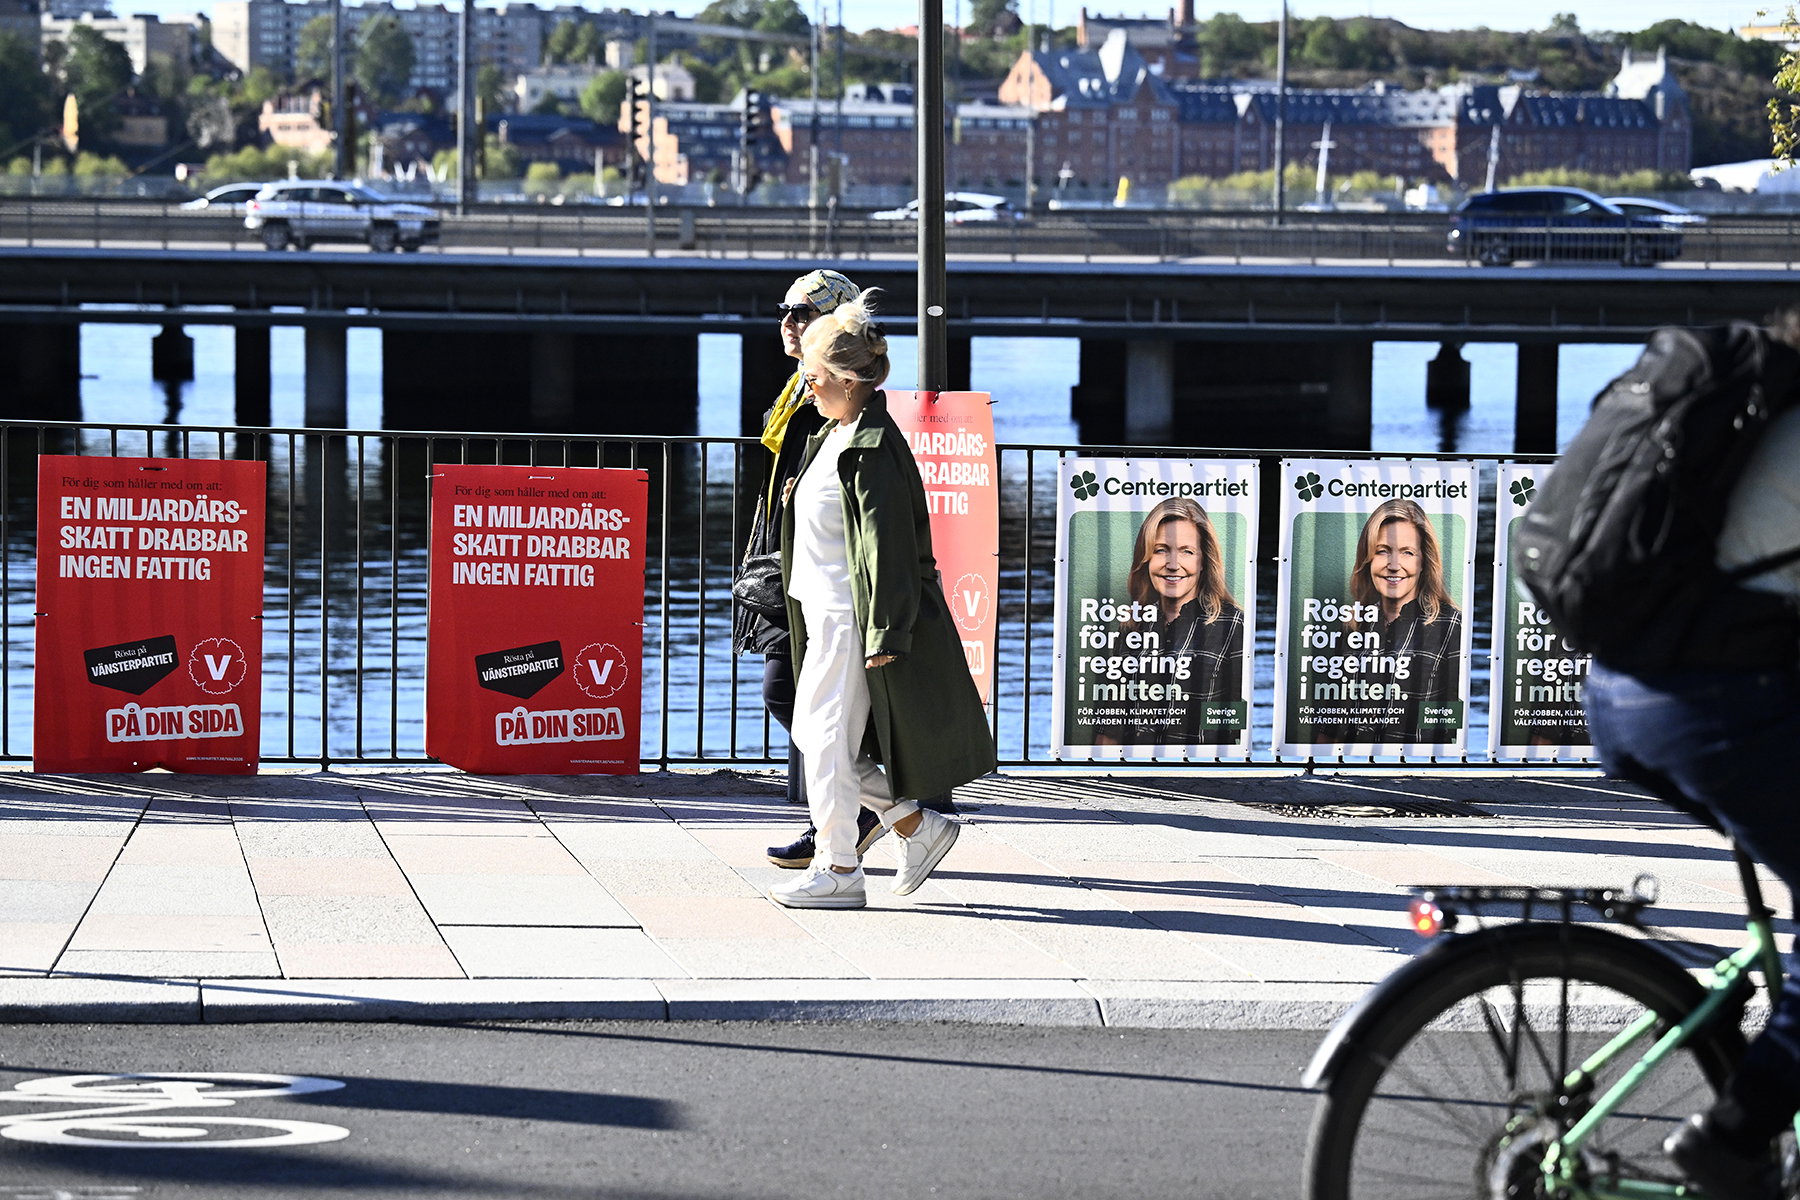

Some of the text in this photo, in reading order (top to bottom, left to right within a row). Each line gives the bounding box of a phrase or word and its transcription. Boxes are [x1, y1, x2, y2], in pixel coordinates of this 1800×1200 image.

[929, 413, 949, 423] med
[901, 428, 988, 456] LJARDÄRS-
[62, 477, 222, 490] För dig som håller med om att:
[455, 486, 606, 500] För dig som håller med om att:
[1104, 477, 1248, 498] Centerpartiet
[1328, 479, 1468, 498] Centerpartiet
[60, 494, 248, 523] EN MILJARDÄRS-
[925, 491, 968, 515] TTIG
[454, 502, 630, 532] EN MILJARDÄRS-
[60, 526, 248, 552] SKATT DRABBAR
[453, 533, 630, 560] SKATT DRABBAR
[60, 555, 210, 580] INGEN FATTIG
[452, 562, 594, 587] INGEN FATTIG
[963, 590, 981, 617] V
[1080, 598, 1158, 622] Rösta
[1303, 598, 1378, 622] Rösta
[1079, 626, 1159, 649] för en
[1301, 625, 1380, 649] för en
[1516, 628, 1556, 652] för
[114, 645, 147, 659] Rösta på
[504, 650, 534, 664] Rösta på
[91, 652, 173, 677] VÄNSTERPARTIET
[204, 654, 232, 680] V
[482, 658, 559, 682] VÄNSTERPARTIET
[588, 660, 614, 685] V
[1079, 650, 1192, 680] regering
[1301, 650, 1411, 680] regering
[1516, 653, 1592, 682] regeri
[1078, 677, 1190, 700] i mitten.
[1300, 676, 1408, 700] i mitten.
[1515, 678, 1583, 702] i mitt
[112, 708, 238, 737] PÅ DIN SIDA
[1078, 707, 1093, 715] FÖR
[1094, 708, 1128, 716] JOBBEN,
[1078, 716, 1122, 725] VÄLFÄRDEN
[1206, 708, 1236, 717] Sverige
[1206, 716, 1221, 724] kan
[1299, 716, 1342, 724] VÄLFÄRDEN
[1316, 708, 1348, 716] JOBBEN,
[1424, 706, 1452, 716] Sverige
[1514, 708, 1530, 716] FÖR
[1531, 710, 1563, 718] JOBBEN,
[1514, 718, 1557, 726] VÄLFÄRDEN
[500, 712, 620, 740] PÅ DIN SIDA
